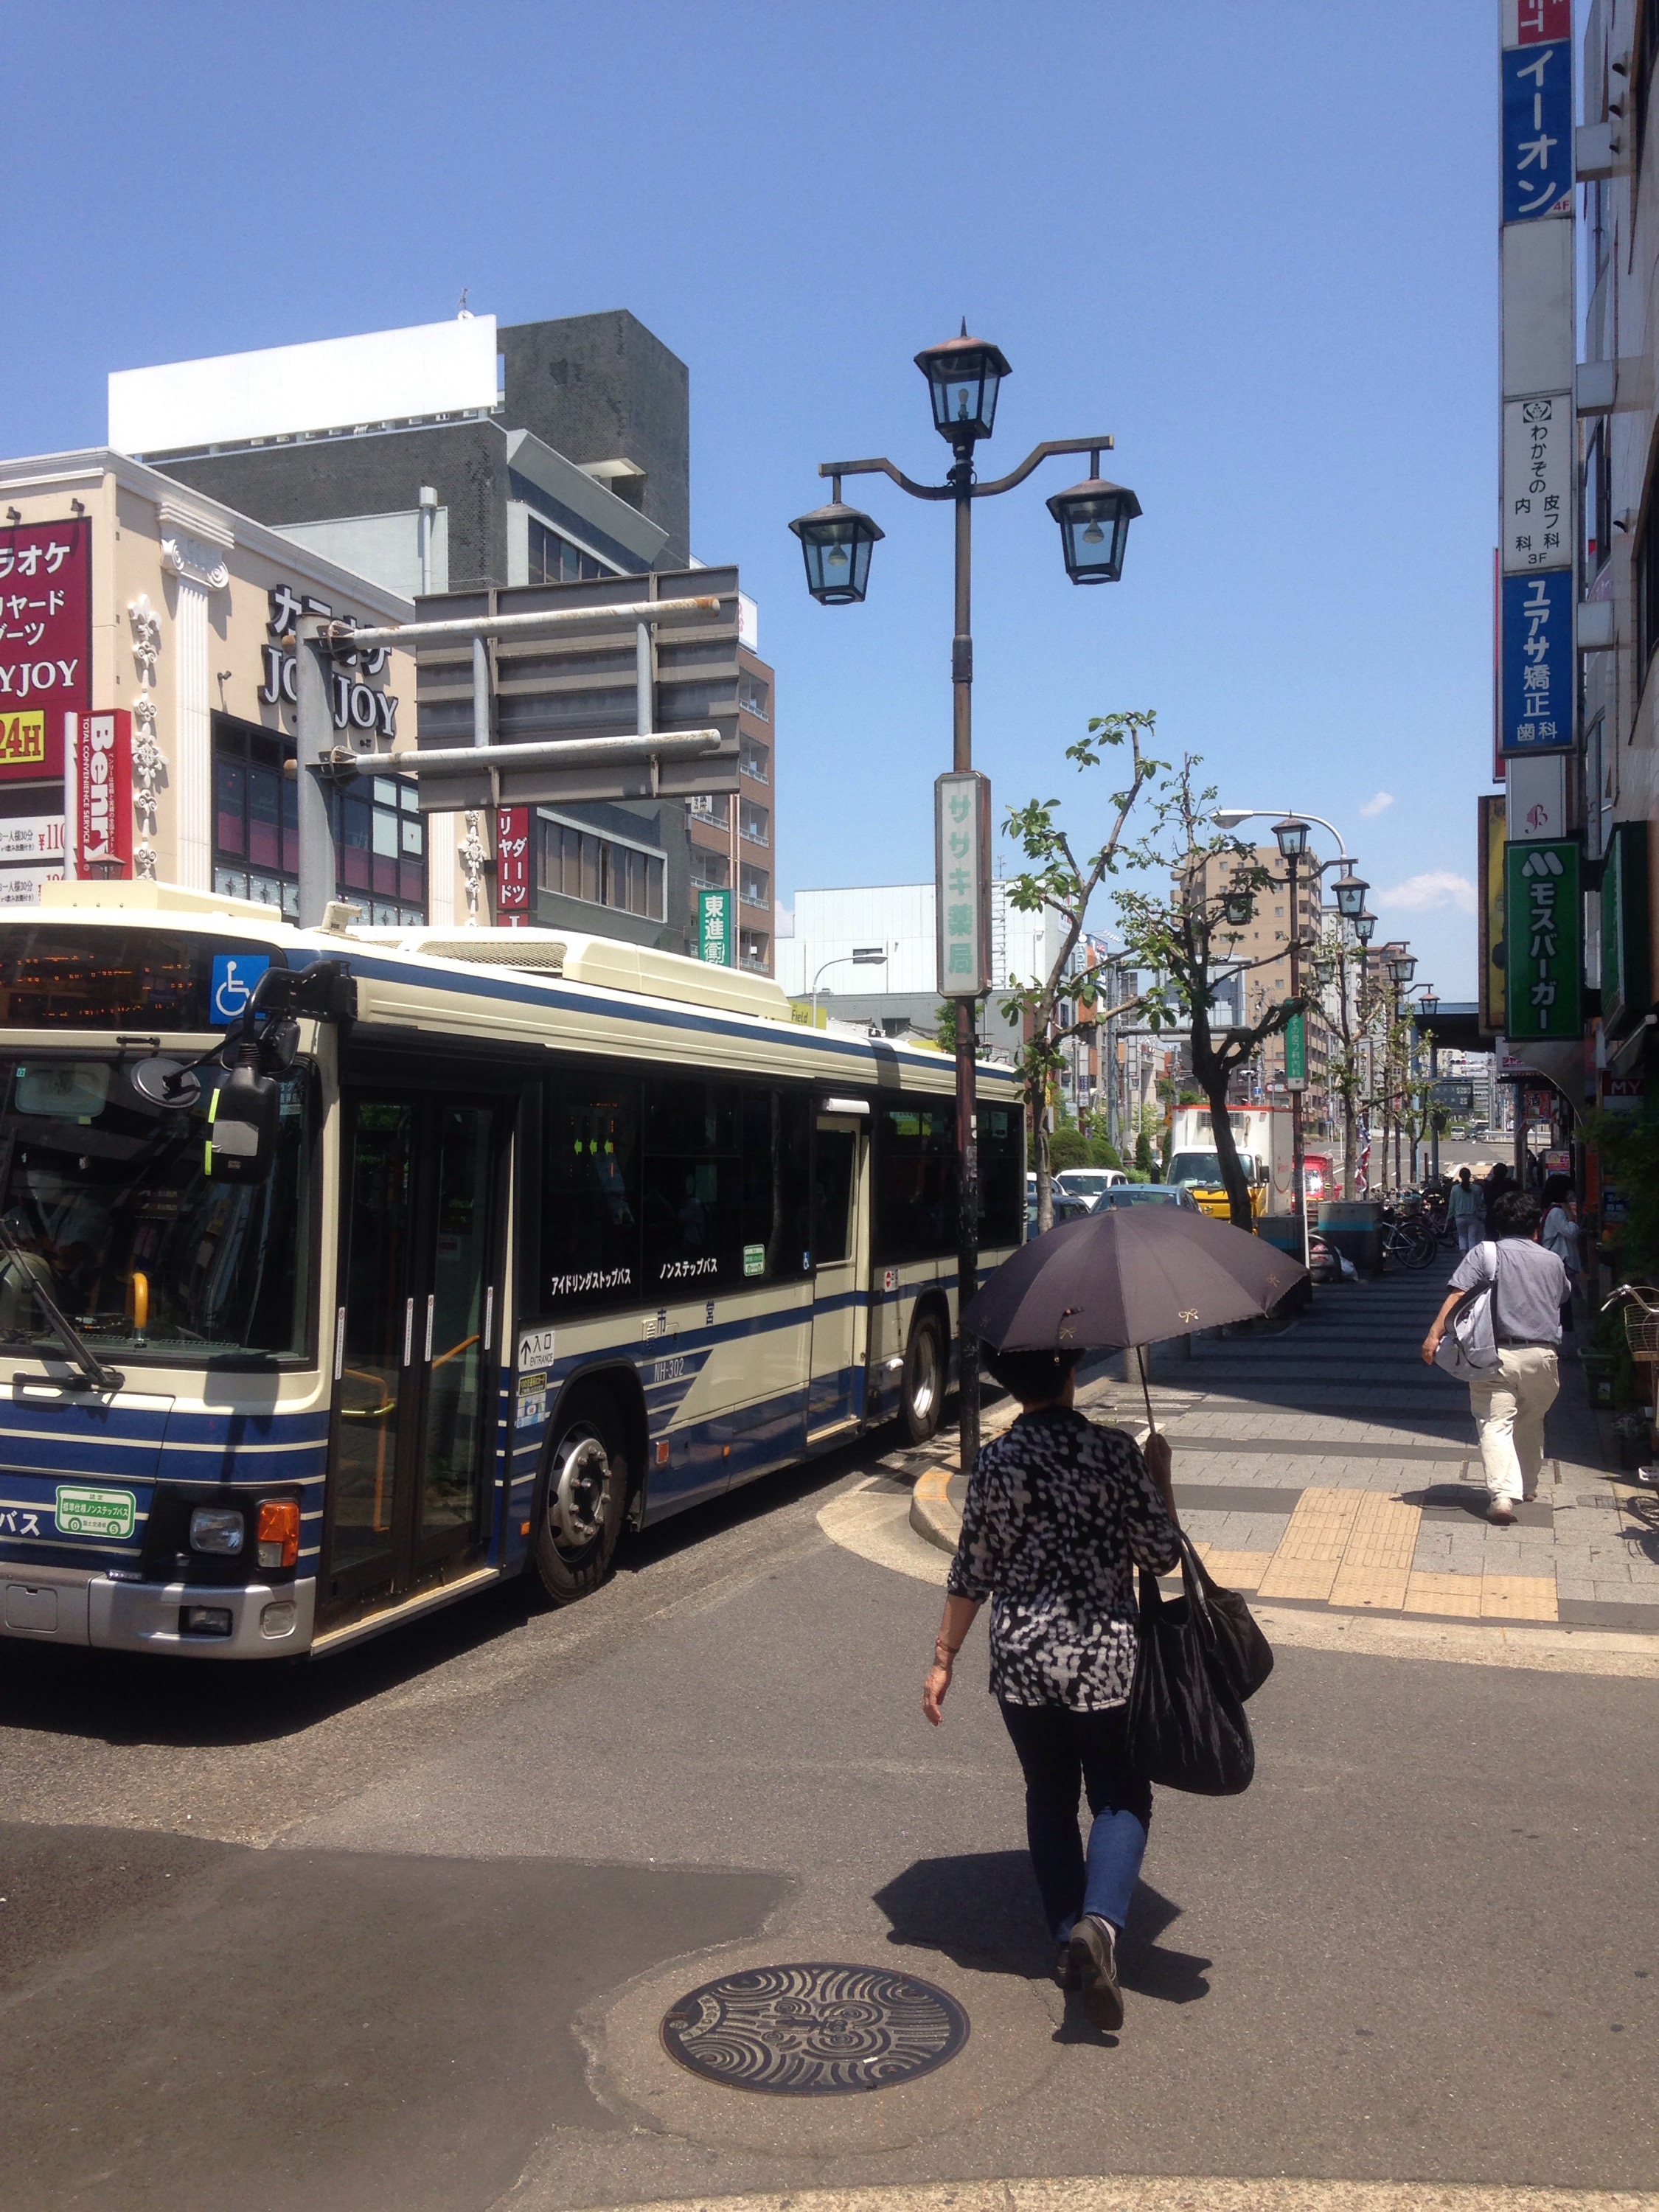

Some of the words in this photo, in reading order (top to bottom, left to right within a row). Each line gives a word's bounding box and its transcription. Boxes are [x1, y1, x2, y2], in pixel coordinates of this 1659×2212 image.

[1517, 49, 1557, 212] イーオン
[1554, 200, 1569, 210] 4F
[1528, 425, 1548, 494] わかぞの
[1515, 498, 1532, 552] 内科
[1543, 494, 1560, 549] 皮フ科
[1528, 553, 1548, 564] 3F
[1523, 580, 1551, 718] ユアサ矯正
[1517, 722, 1557, 742] 歯科
[84, 715, 114, 862] Benry
[498, 808, 514, 905] リヤード
[512, 837, 527, 904] ダーツ
[1529, 883, 1558, 1029] モスバーガー
[791, 1009, 809, 1023] Field
[552, 1268, 632, 1295] アイドリングストップバス
[659, 1258, 718, 1280] ノンステップバス
[530, 1353, 553, 1367] ENTRANCE
[533, 1333, 552, 1353] 入口
[654, 1357, 685, 1382] NH-302
